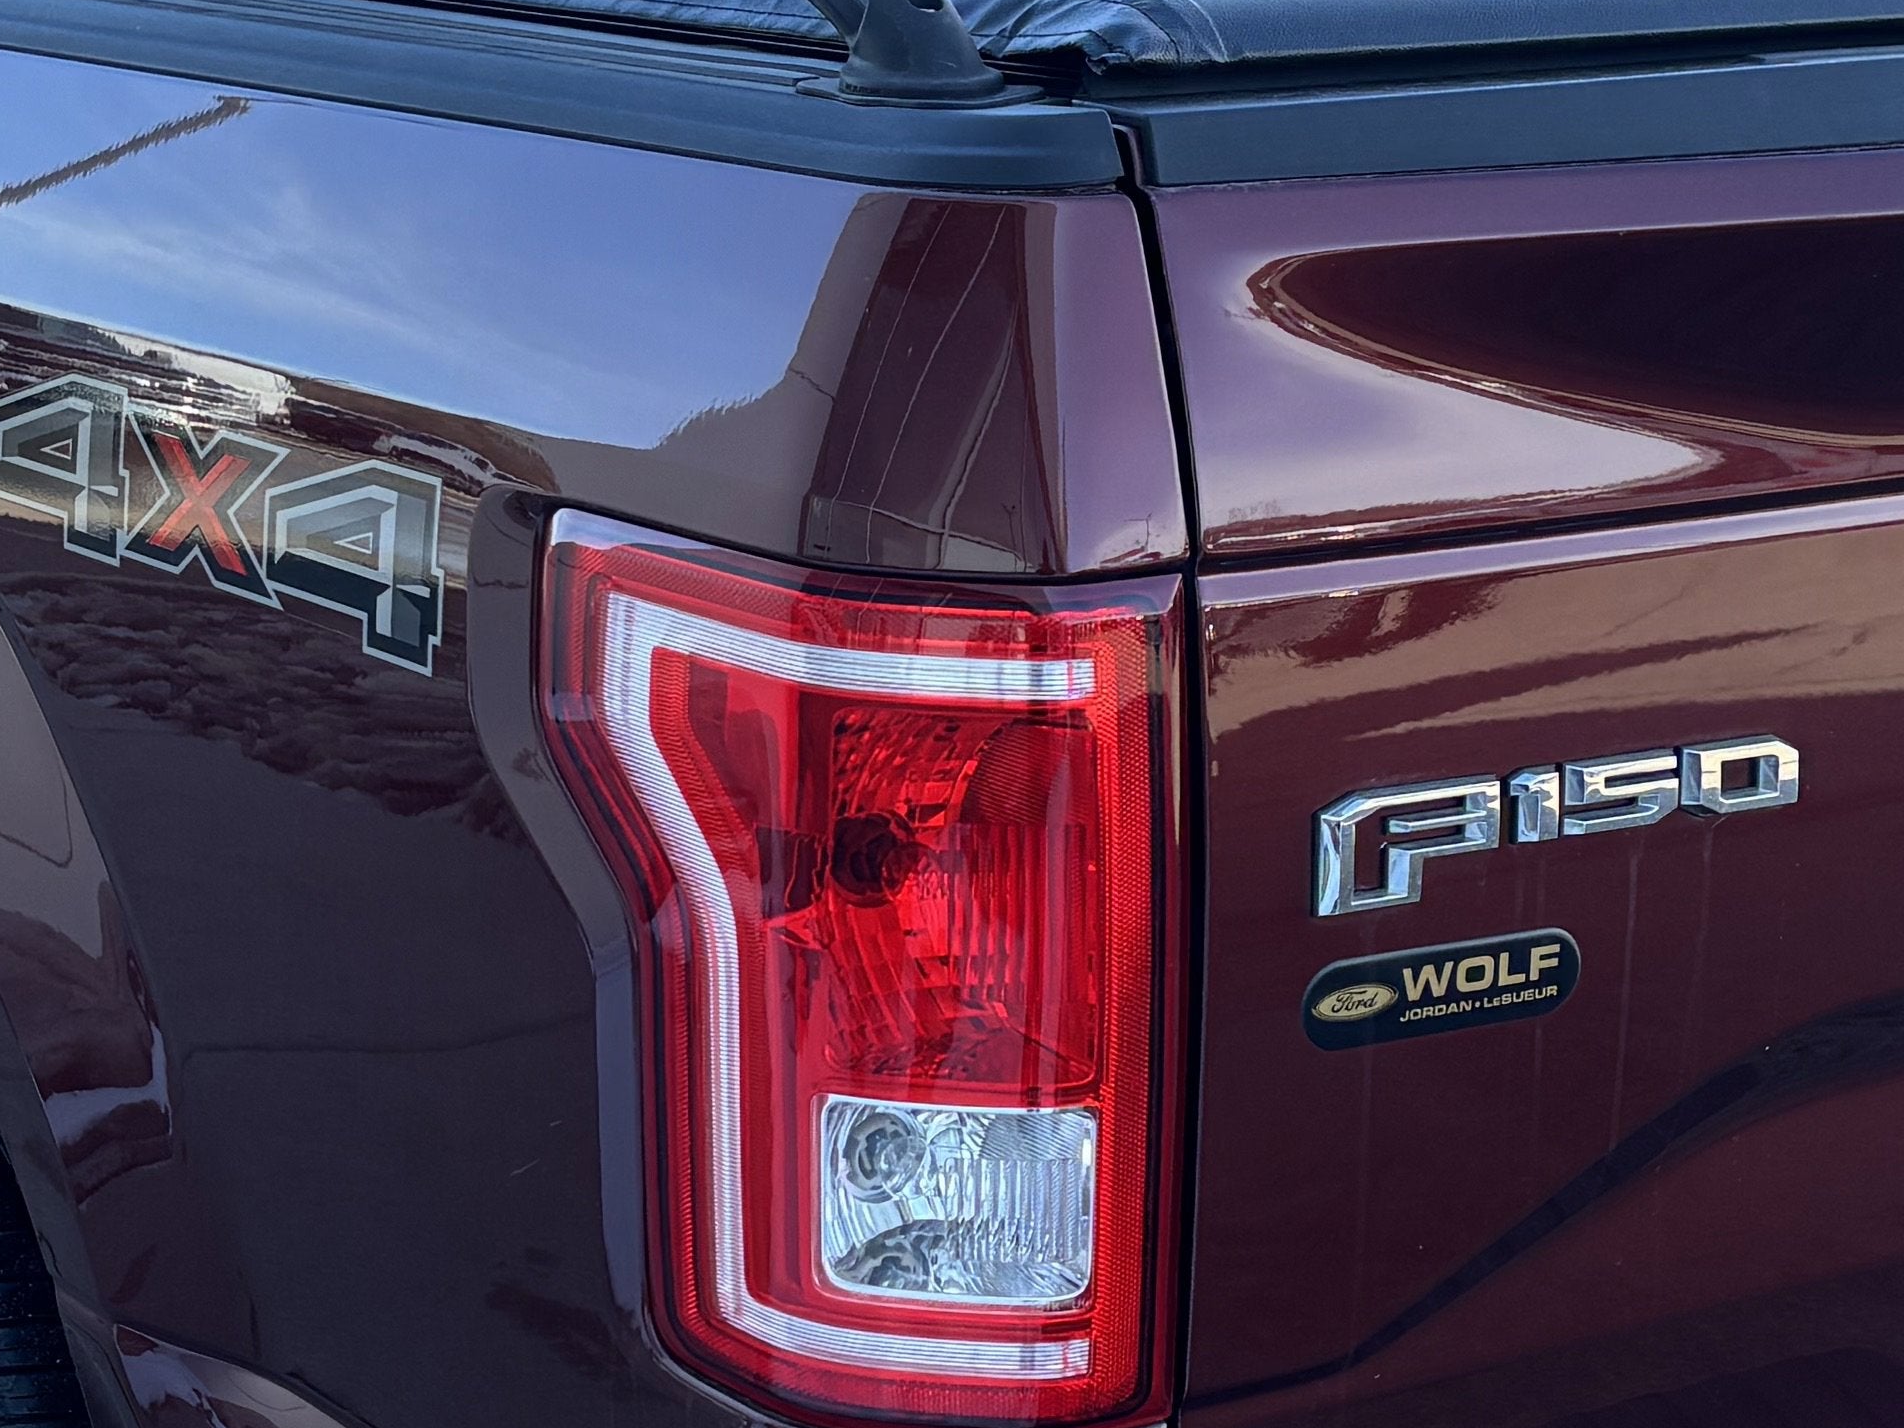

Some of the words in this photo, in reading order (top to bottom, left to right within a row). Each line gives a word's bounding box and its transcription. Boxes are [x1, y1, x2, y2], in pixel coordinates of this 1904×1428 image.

[1330, 988, 1379, 1014] Ford
[1402, 943, 1561, 1002] WOLF
[1399, 999, 1472, 1022] JORDAN
[1483, 984, 1558, 1008] LeSUEUR
